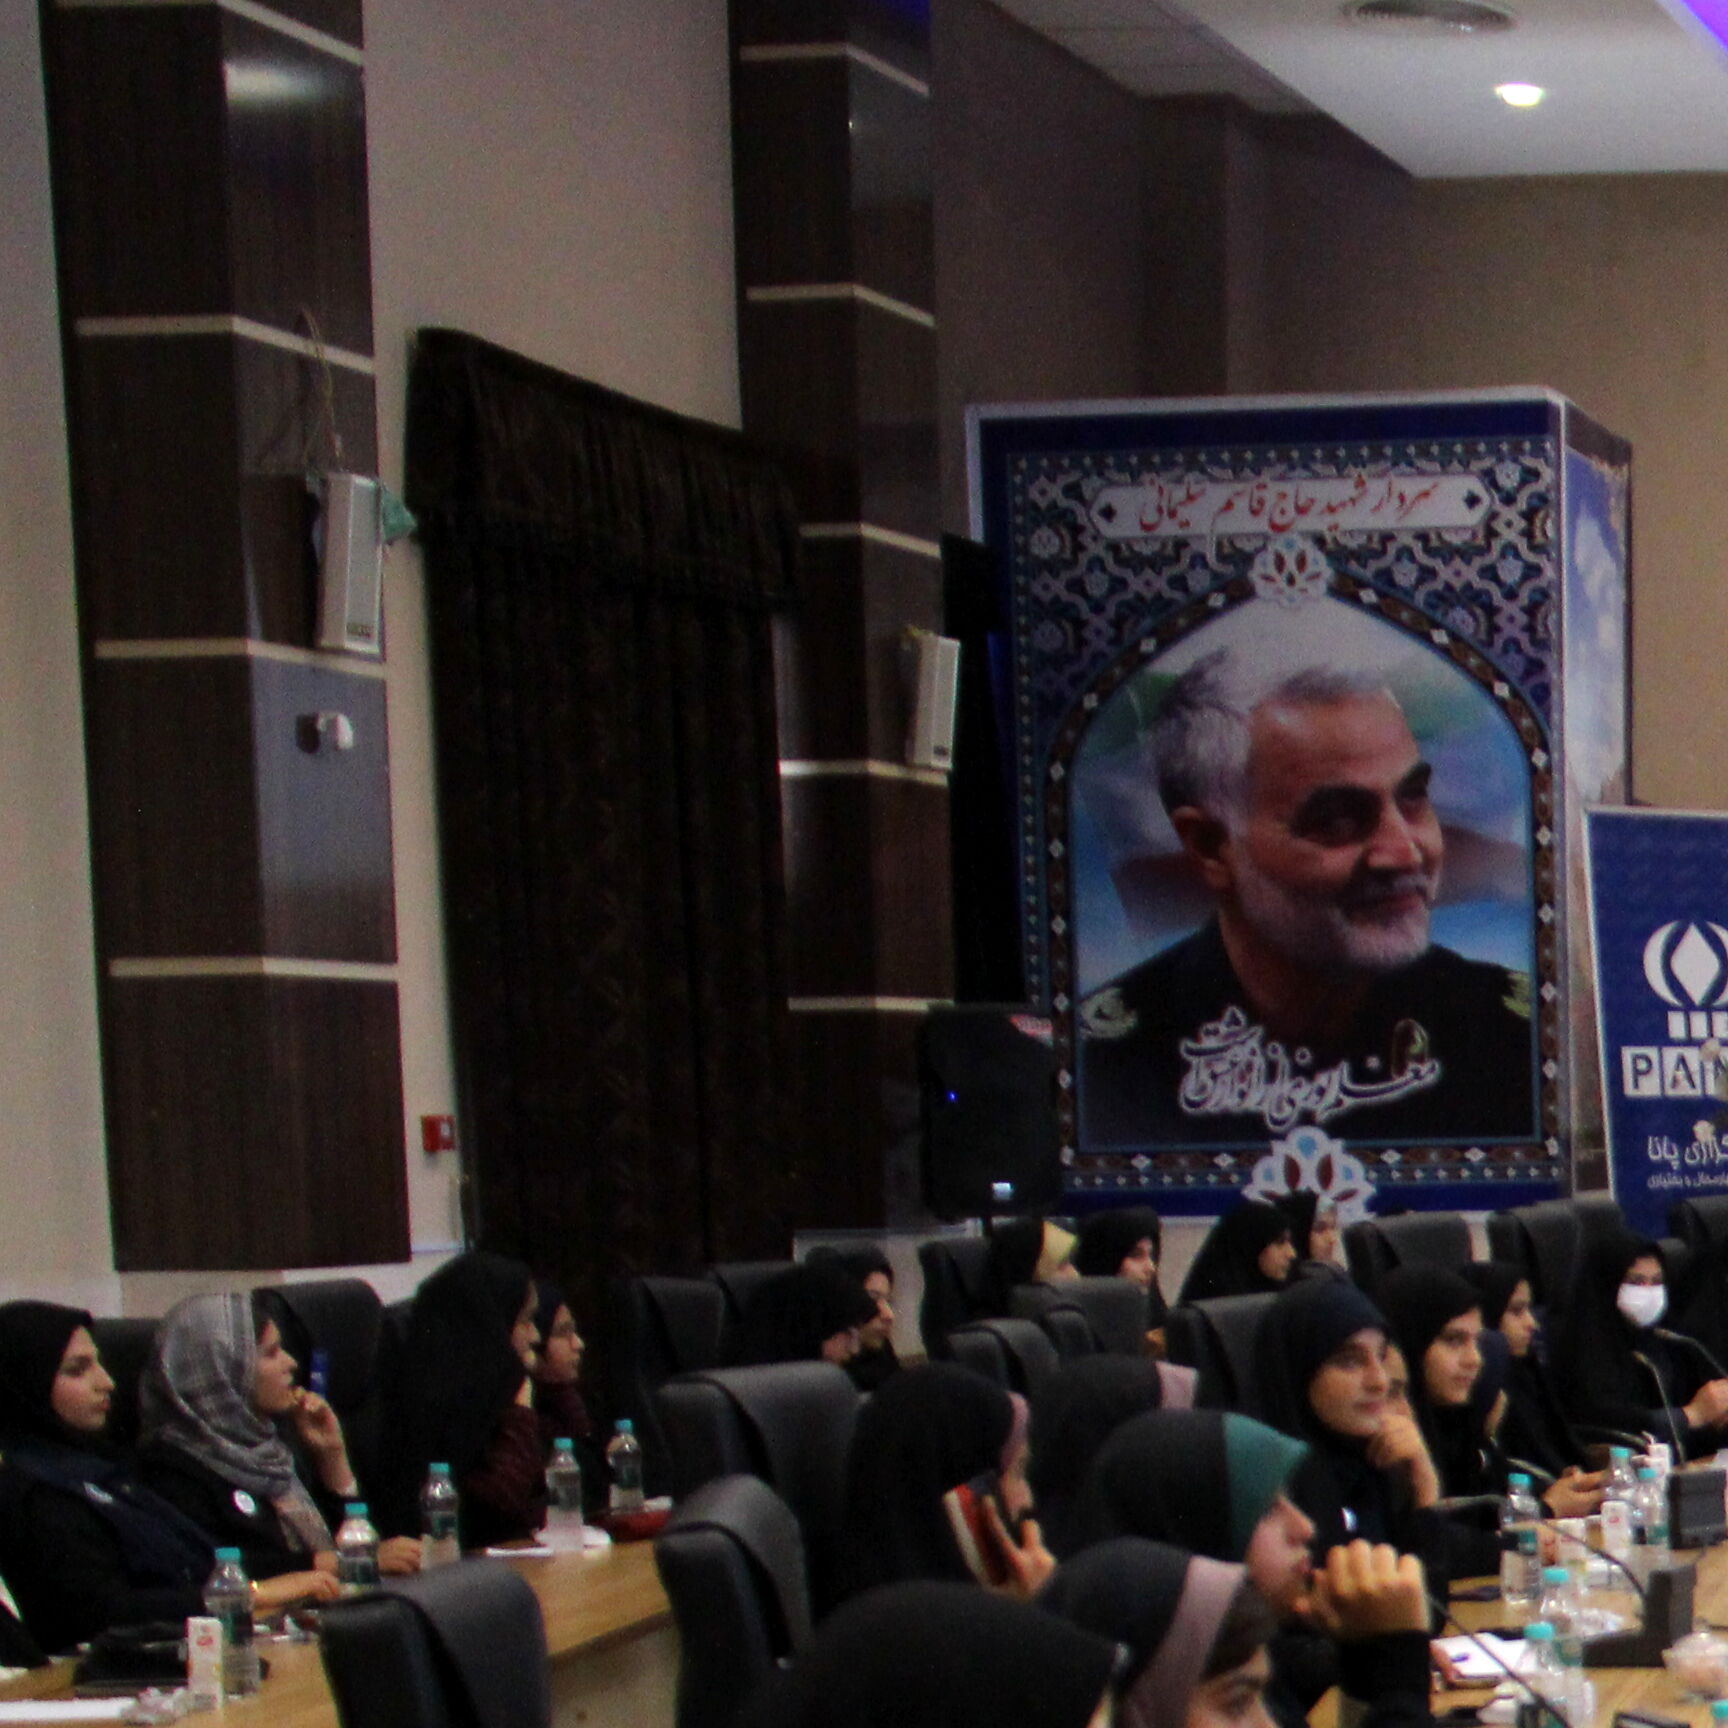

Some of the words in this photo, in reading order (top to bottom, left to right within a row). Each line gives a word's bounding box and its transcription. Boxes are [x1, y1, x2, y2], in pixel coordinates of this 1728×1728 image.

[1138, 476, 1206, 533] سلیمانی
[1211, 480, 1268, 552] قاسم
[1268, 484, 1316, 533] حاج
[1320, 472, 1368, 533] شهید
[1370, 473, 1438, 521] سردار
[1647, 1135, 1681, 1170] پانا
[1647, 1173, 1684, 1189] بختیاری
